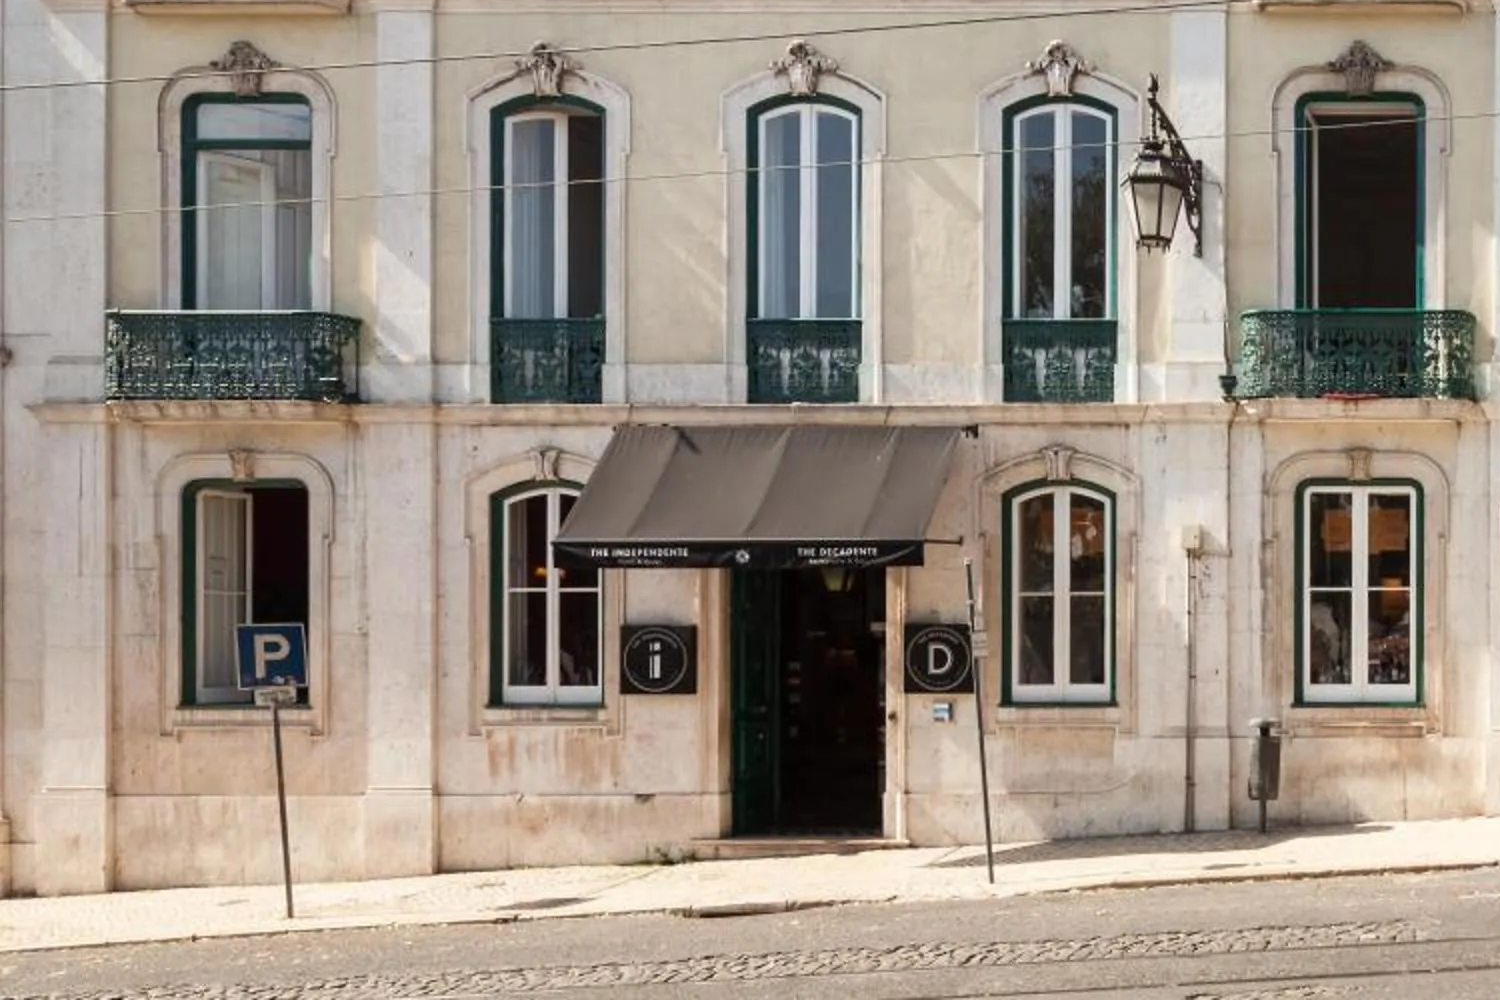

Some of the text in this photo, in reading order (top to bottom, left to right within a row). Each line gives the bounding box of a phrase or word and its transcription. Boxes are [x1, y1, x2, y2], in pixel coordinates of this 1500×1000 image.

[591, 547, 689, 557] THE INDEPENDENTE
[797, 547, 878, 557] THE DECADENTE
[253, 633, 291, 679] P
[927, 643, 952, 675] D
